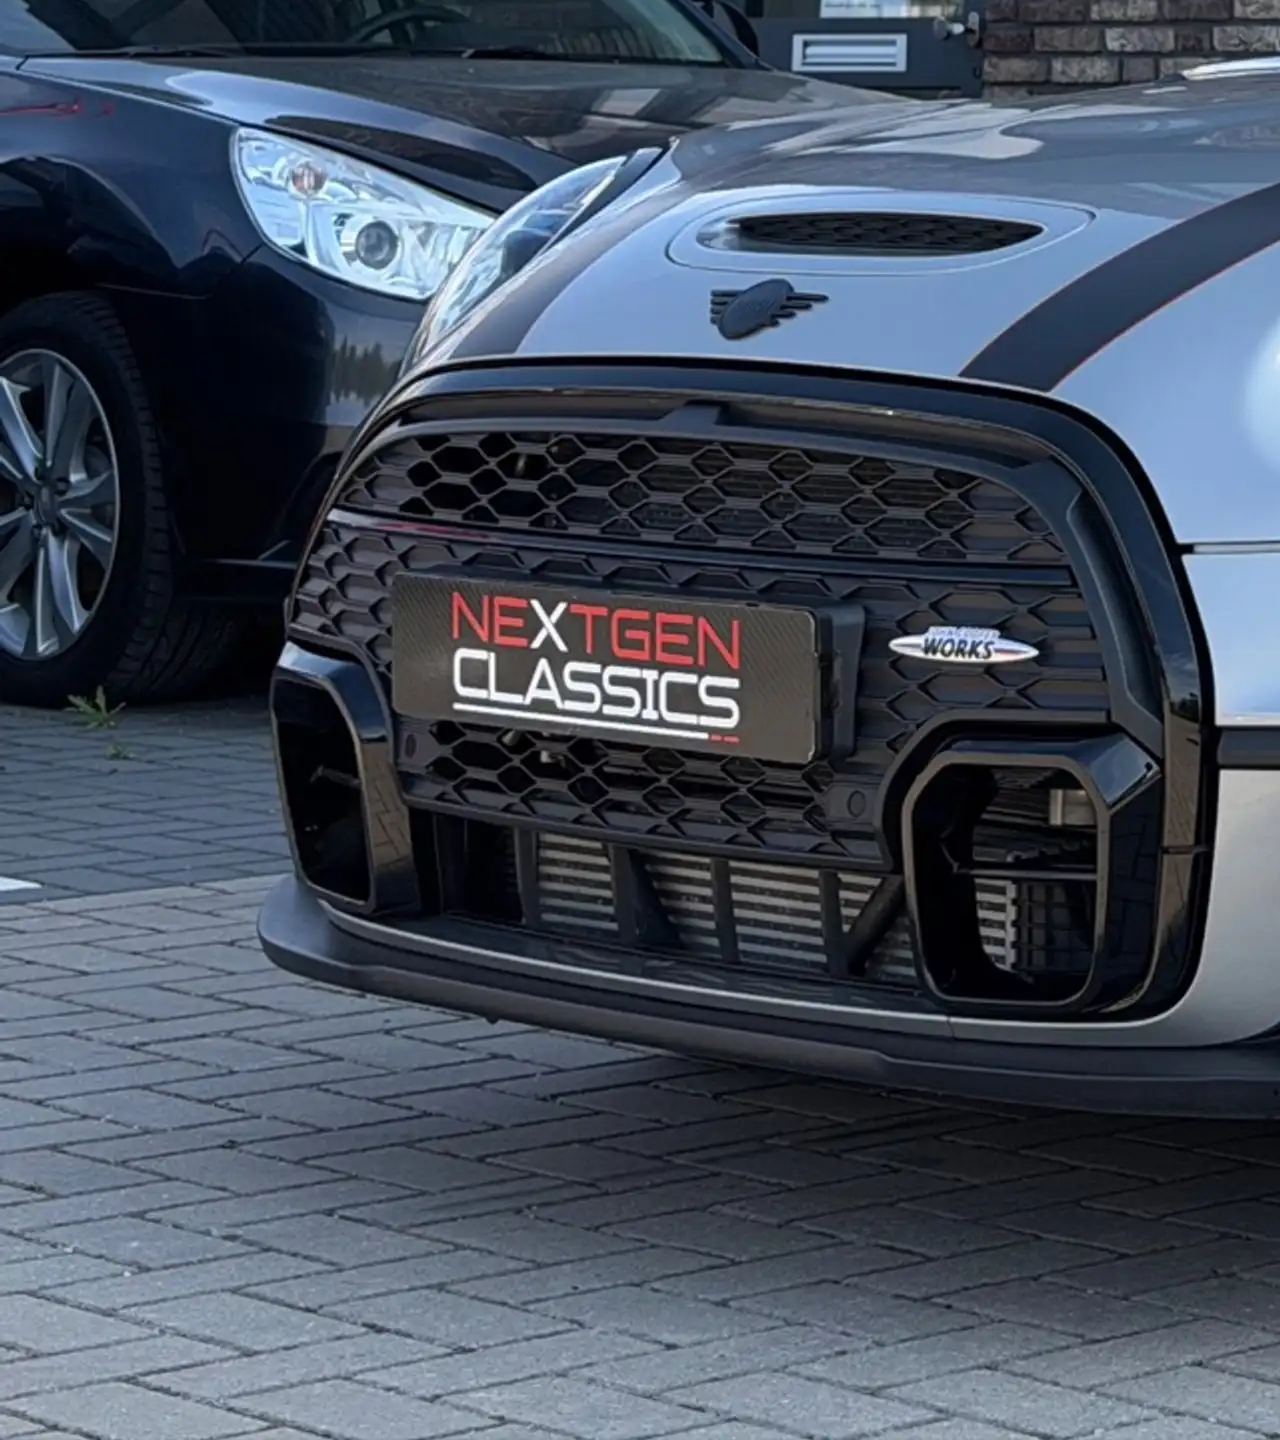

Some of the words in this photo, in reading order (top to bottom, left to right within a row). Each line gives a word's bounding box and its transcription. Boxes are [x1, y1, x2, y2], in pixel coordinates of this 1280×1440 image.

[452, 591, 740, 670] NEXTGEN
[921, 638, 995, 659] WORKS
[452, 647, 741, 730] CLASSICS
